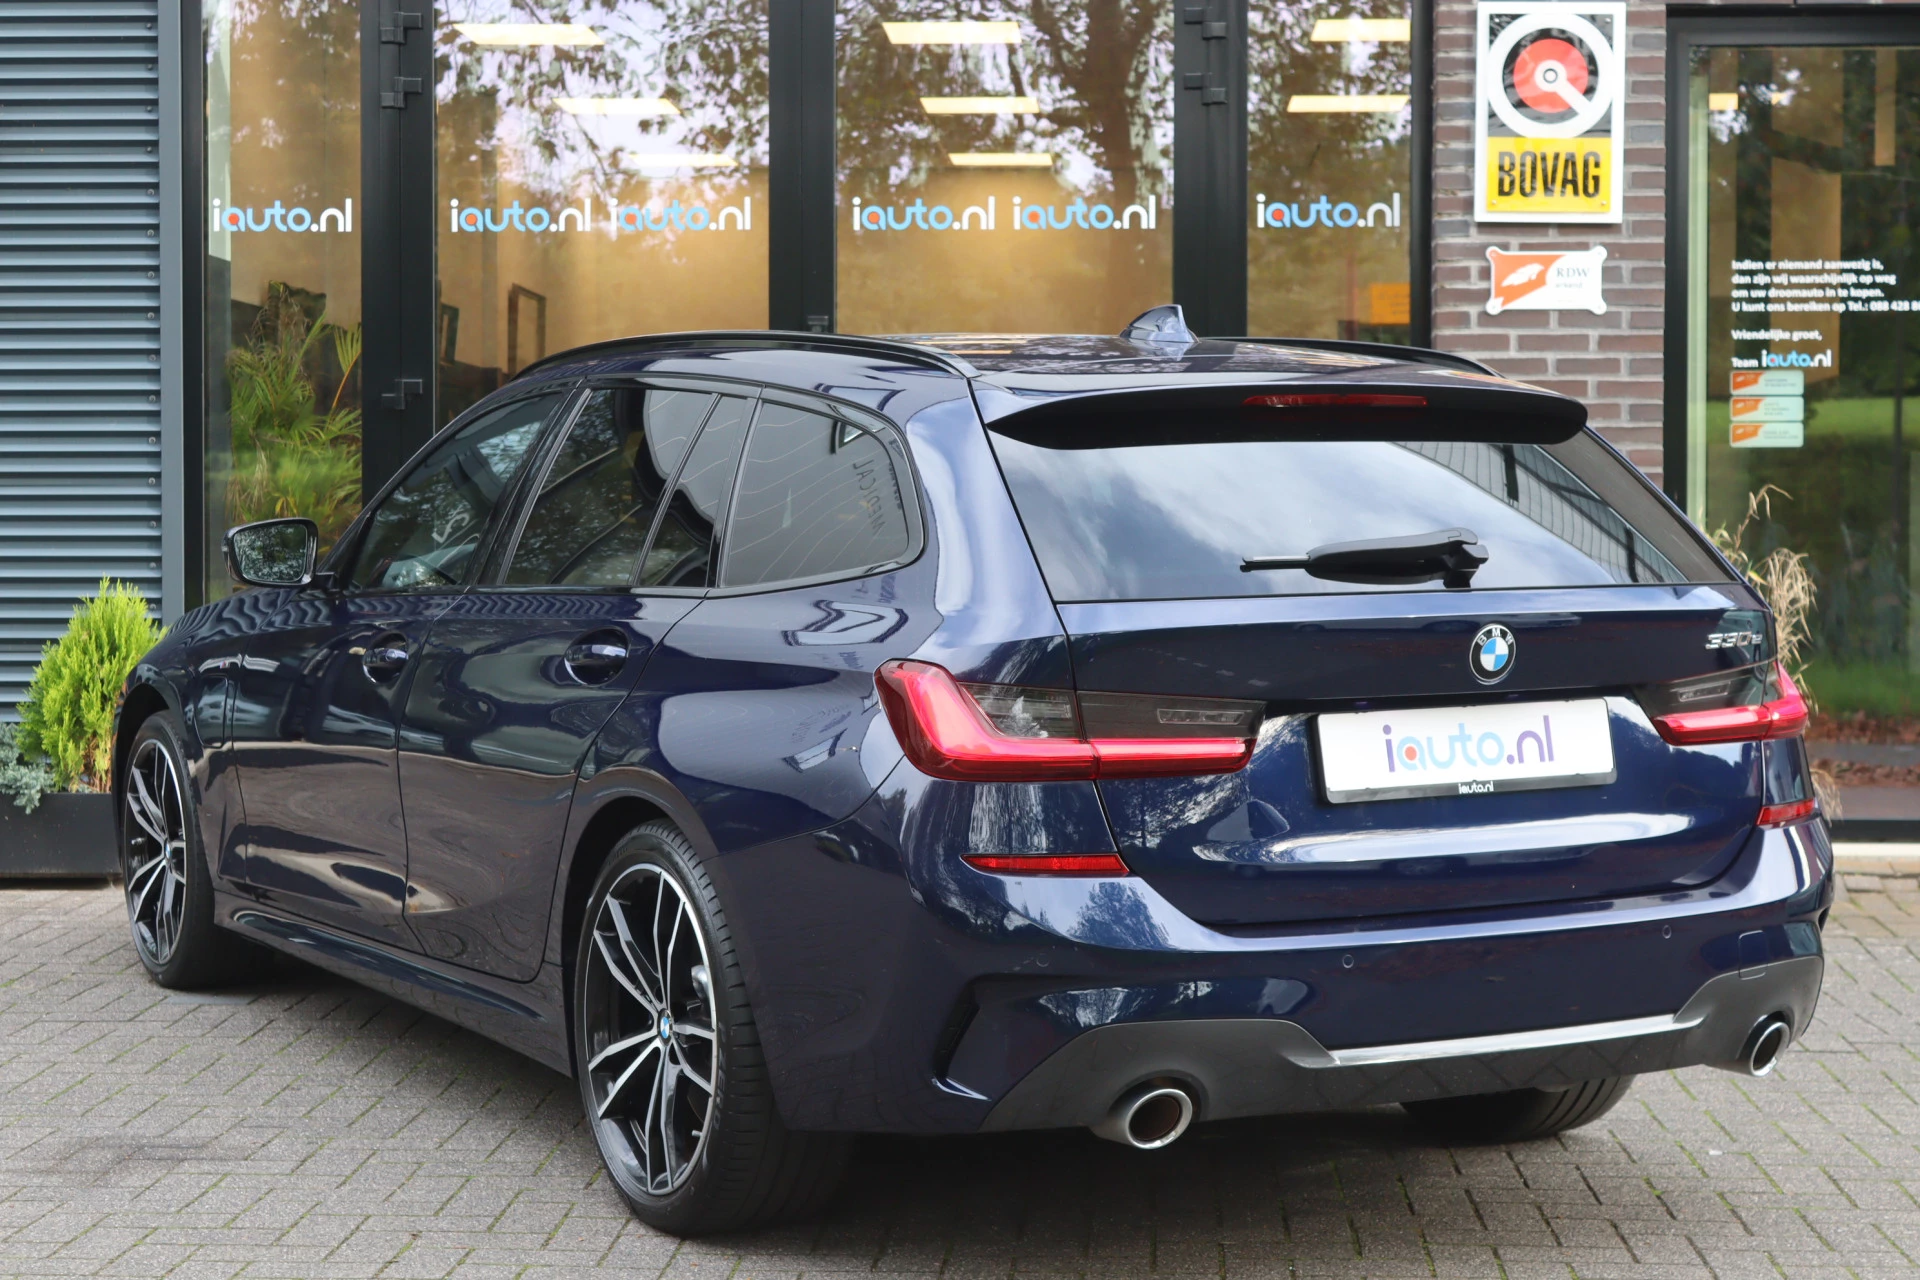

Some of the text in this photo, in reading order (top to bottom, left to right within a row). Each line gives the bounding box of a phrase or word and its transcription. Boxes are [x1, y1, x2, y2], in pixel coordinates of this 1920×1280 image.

[1497, 151, 1601, 198] BOVAG
[213, 198, 352, 233] iauto.nl
[450, 198, 591, 233] iauto.nl
[610, 197, 751, 232] iauto.nl
[852, 196, 995, 231] iauto.nl
[1013, 195, 1156, 231] iauto.nl
[1257, 193, 1400, 228] iauto.nl
[1556, 267, 1590, 278] RDW
[1731, 258, 1884, 271] Indien er niemand aanwezig is,
[1731, 272, 1897, 286] dan zijn wij waarschijnlijk op weg
[1731, 287, 1884, 299] om uw droomauto in te kopen.
[1731, 302, 1741, 312] U
[1742, 301, 1765, 312] kunt
[1767, 303, 1785, 312] ons
[1787, 301, 1830, 312] bereiken
[1832, 303, 1846, 313] op
[1731, 329, 1823, 342] Vriendelijke groet,
[1731, 349, 1832, 368] Team iauto.nl
[1477, 628, 1514, 646] BMW
[1705, 631, 1763, 649] 330e
[1382, 714, 1555, 773] iauto.nl
[1458, 781, 1494, 794] iauto.nl
